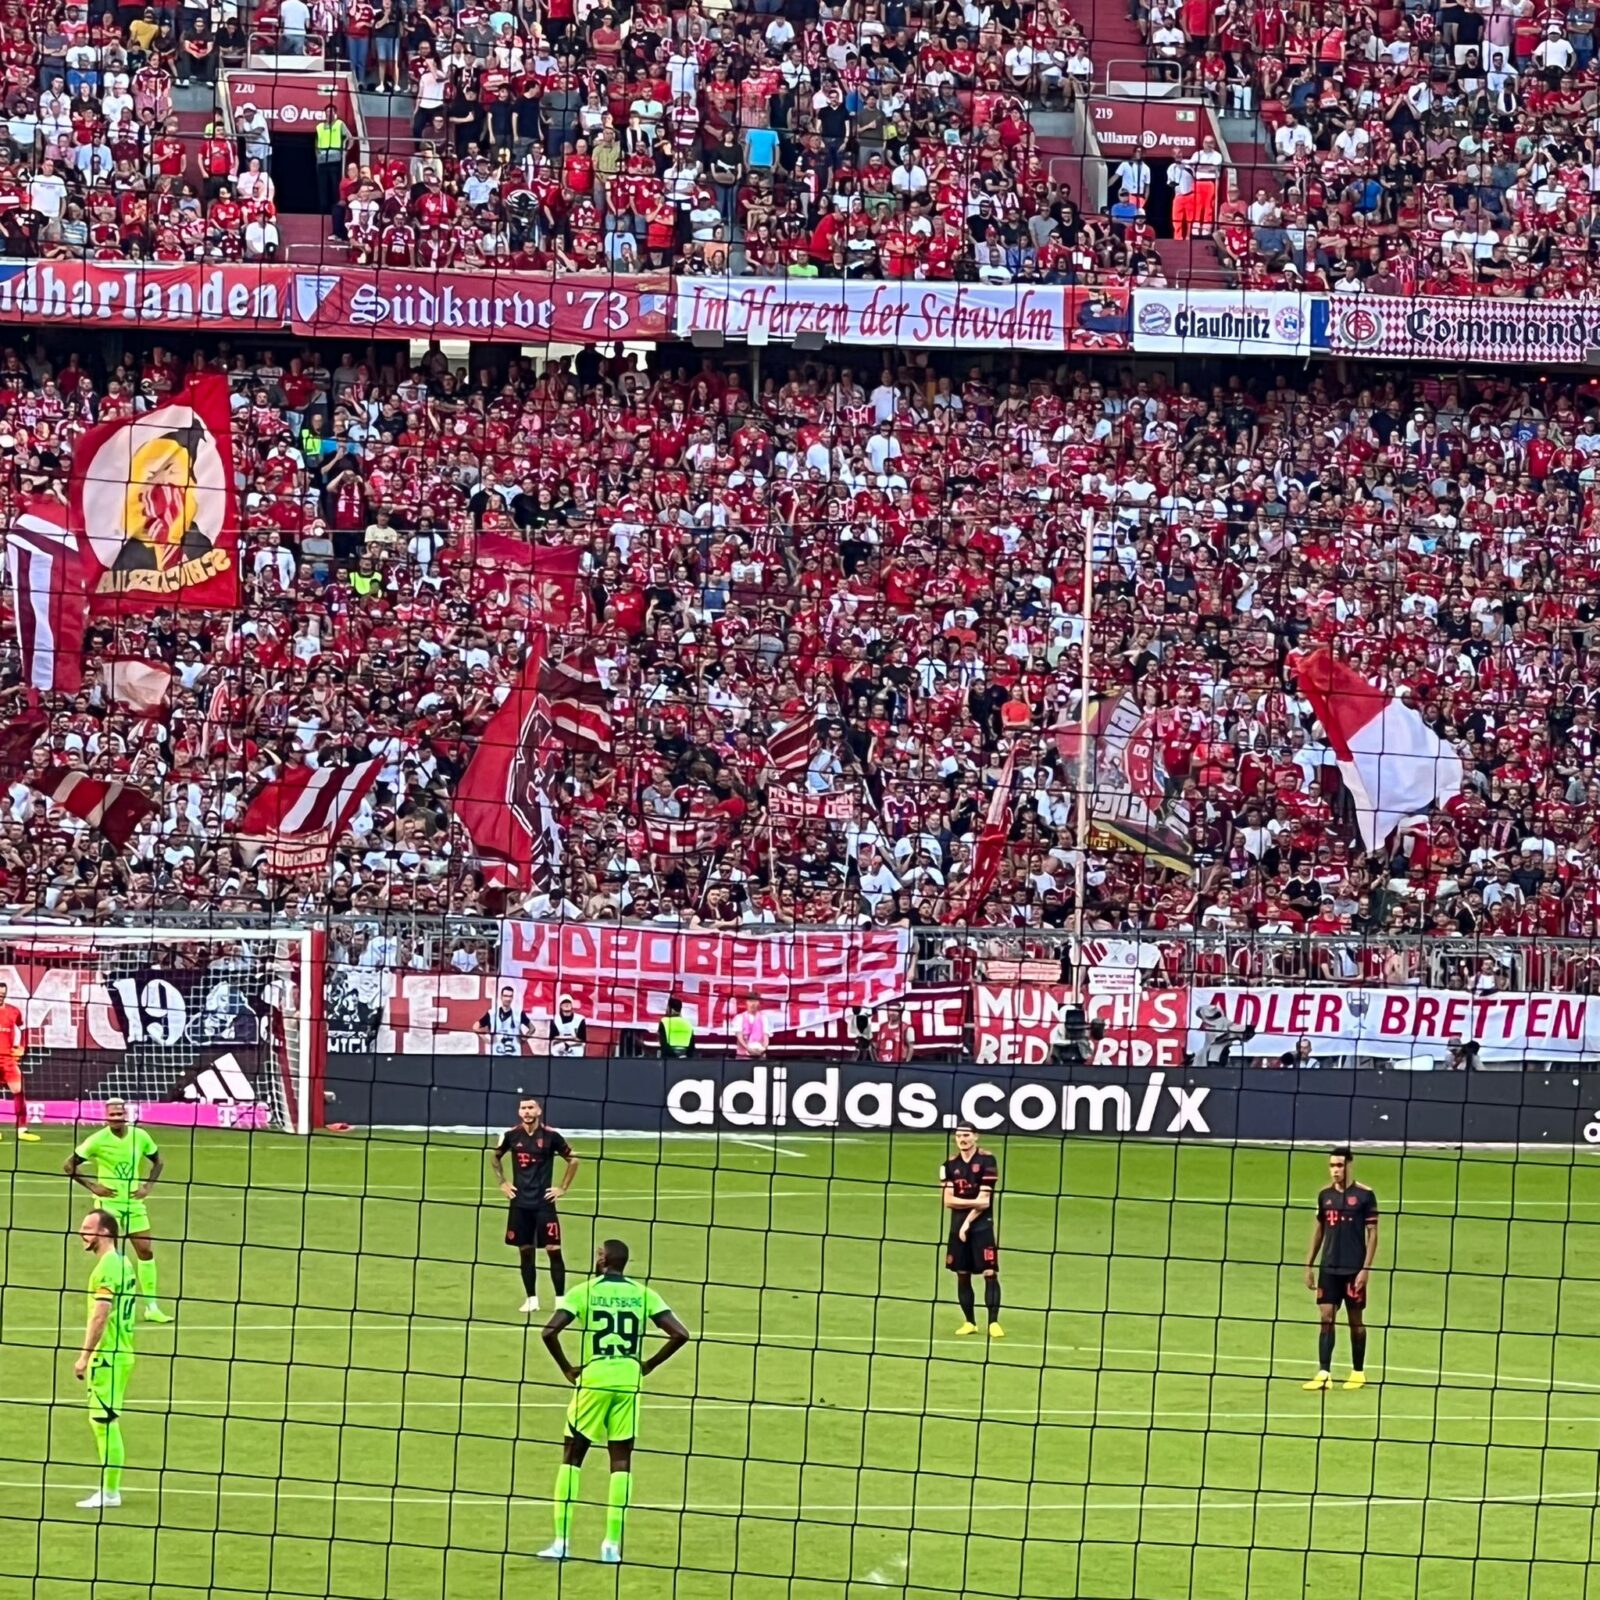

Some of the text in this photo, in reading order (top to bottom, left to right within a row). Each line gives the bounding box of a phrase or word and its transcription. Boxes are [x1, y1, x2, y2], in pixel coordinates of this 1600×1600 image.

[1095, 108, 1113, 119] 219
[1096, 131, 1195, 146] Allianz Arena
[349, 284, 630, 330] Südkurve '73
[687, 284, 1054, 342] Im Herzen der Schwalm
[1175, 312, 1270, 339] Claußnitz
[1406, 307, 1600, 346] Command
[979, 986, 1178, 1032] MUNCH'S
[1207, 992, 1586, 1040] ADLER BRETTEN
[976, 1033, 1049, 1064] RED
[667, 1066, 1211, 1133] adidas.com/x
[593, 1310, 639, 1355] 29
